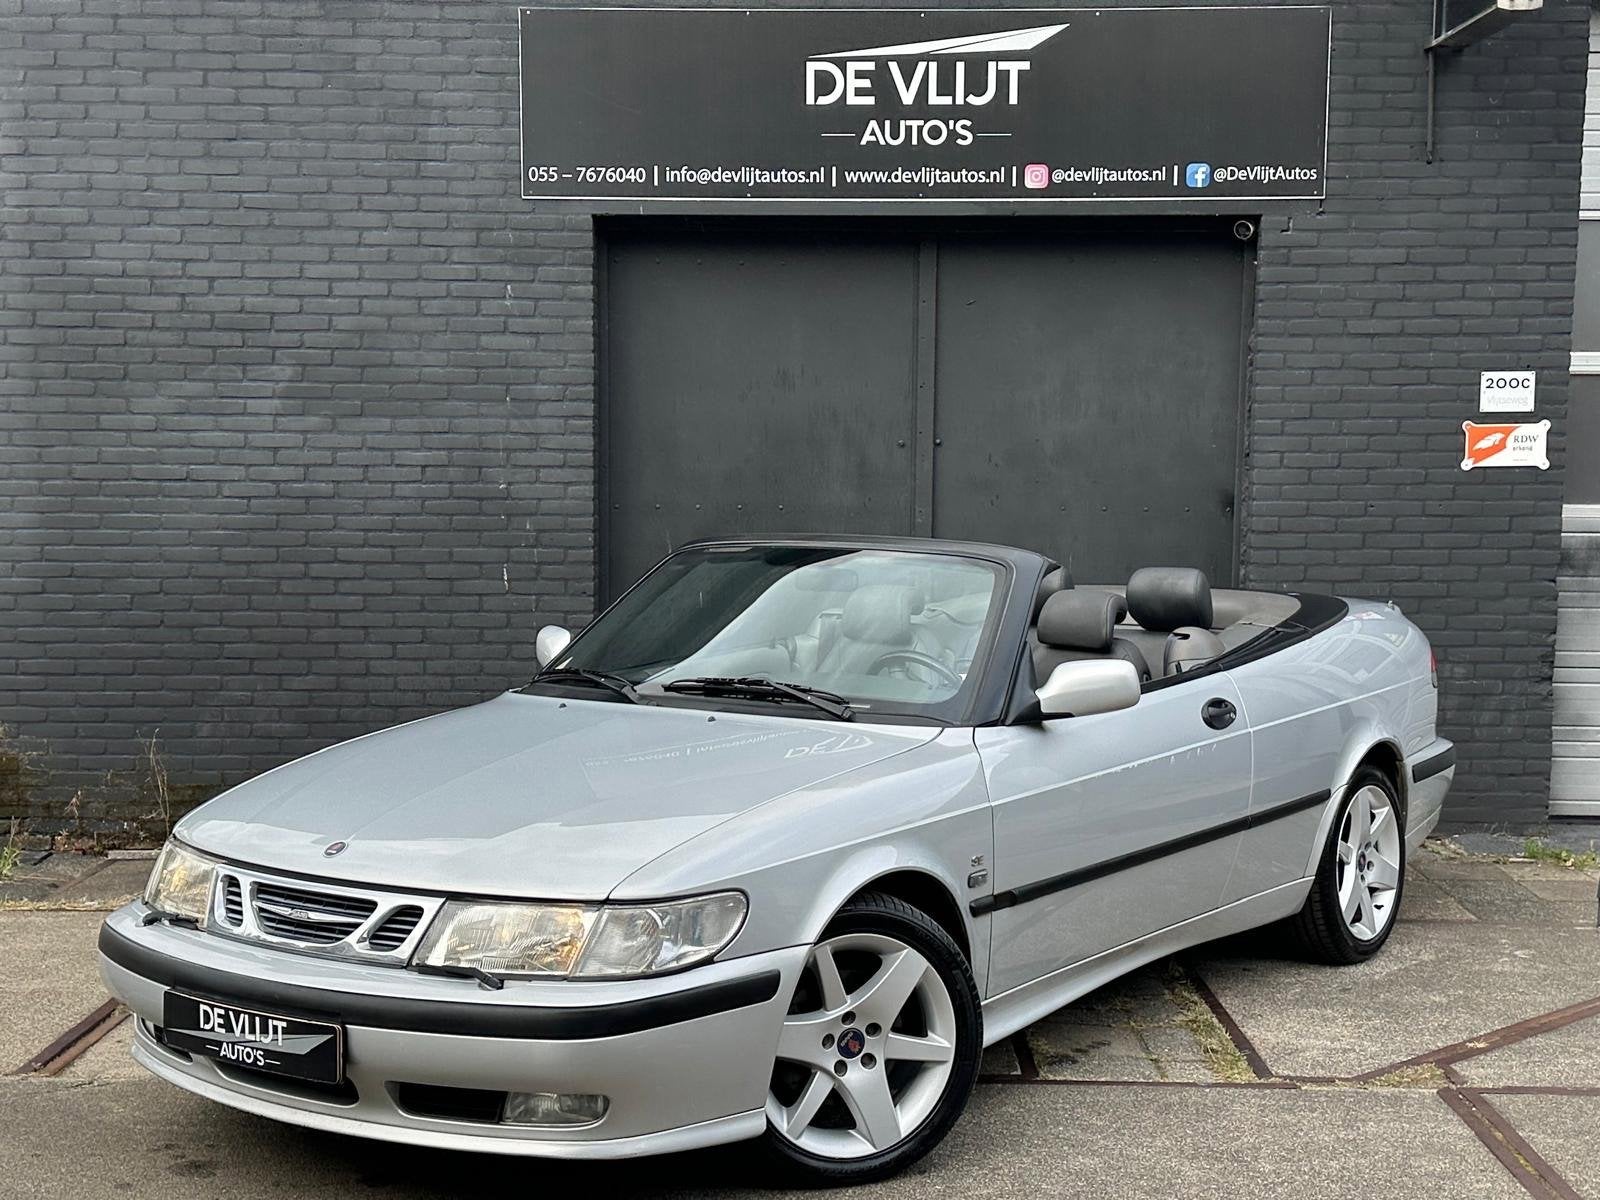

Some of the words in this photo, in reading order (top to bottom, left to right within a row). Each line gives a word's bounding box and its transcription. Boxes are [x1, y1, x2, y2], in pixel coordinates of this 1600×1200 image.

[805, 61, 876, 106] DE
[887, 61, 1031, 106] VLIJT
[859, 119, 974, 146] AUTO'S
[528, 166, 558, 183] 055
[576, 166, 647, 183] 7676040
[665, 165, 825, 186] info@devlijtautos.nl
[844, 166, 1005, 187] www.devlijtautos.nl
[1051, 166, 1166, 185] @devlijtautos.nl
[1213, 165, 1318, 184] @DeVlijtAutos
[1485, 377, 1530, 389] 200C
[1512, 434, 1539, 443] RDW
[199, 1004, 226, 1034] DE
[229, 1010, 287, 1046] VLIJT
[219, 1042, 265, 1067] AUTO'S
